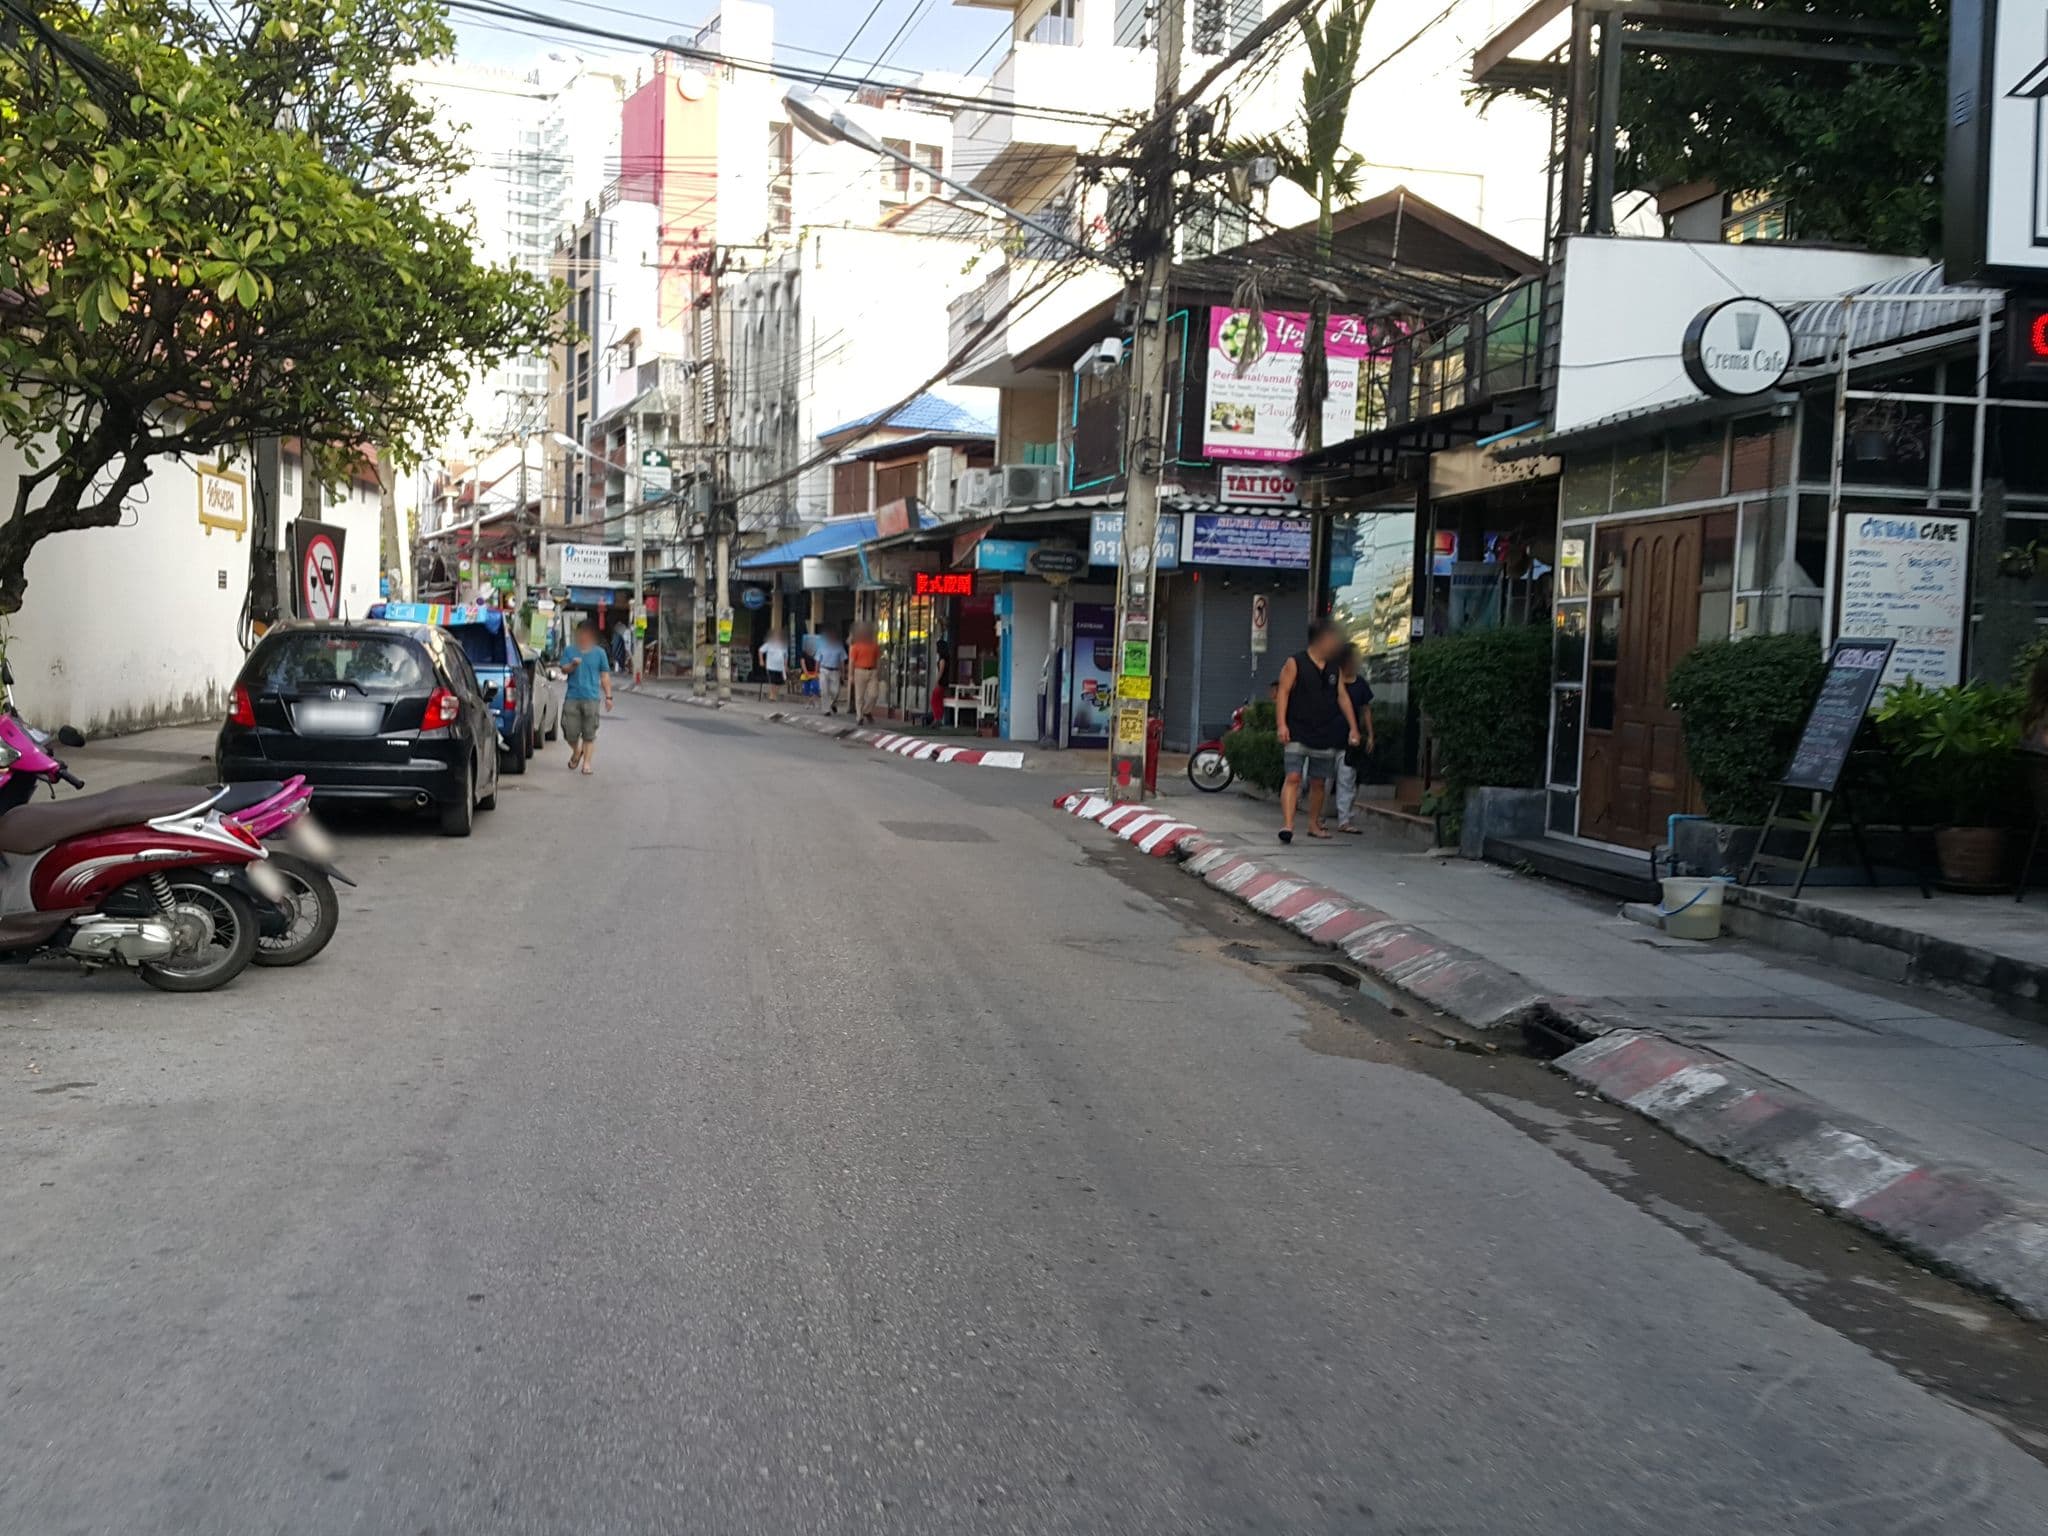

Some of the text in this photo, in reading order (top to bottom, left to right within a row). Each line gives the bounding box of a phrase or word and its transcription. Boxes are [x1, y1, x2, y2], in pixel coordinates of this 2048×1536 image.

[1705, 346, 1785, 372] Crema Cafe
[1226, 474, 1296, 493] TATTOO
[1920, 522, 1959, 541] CAFE
